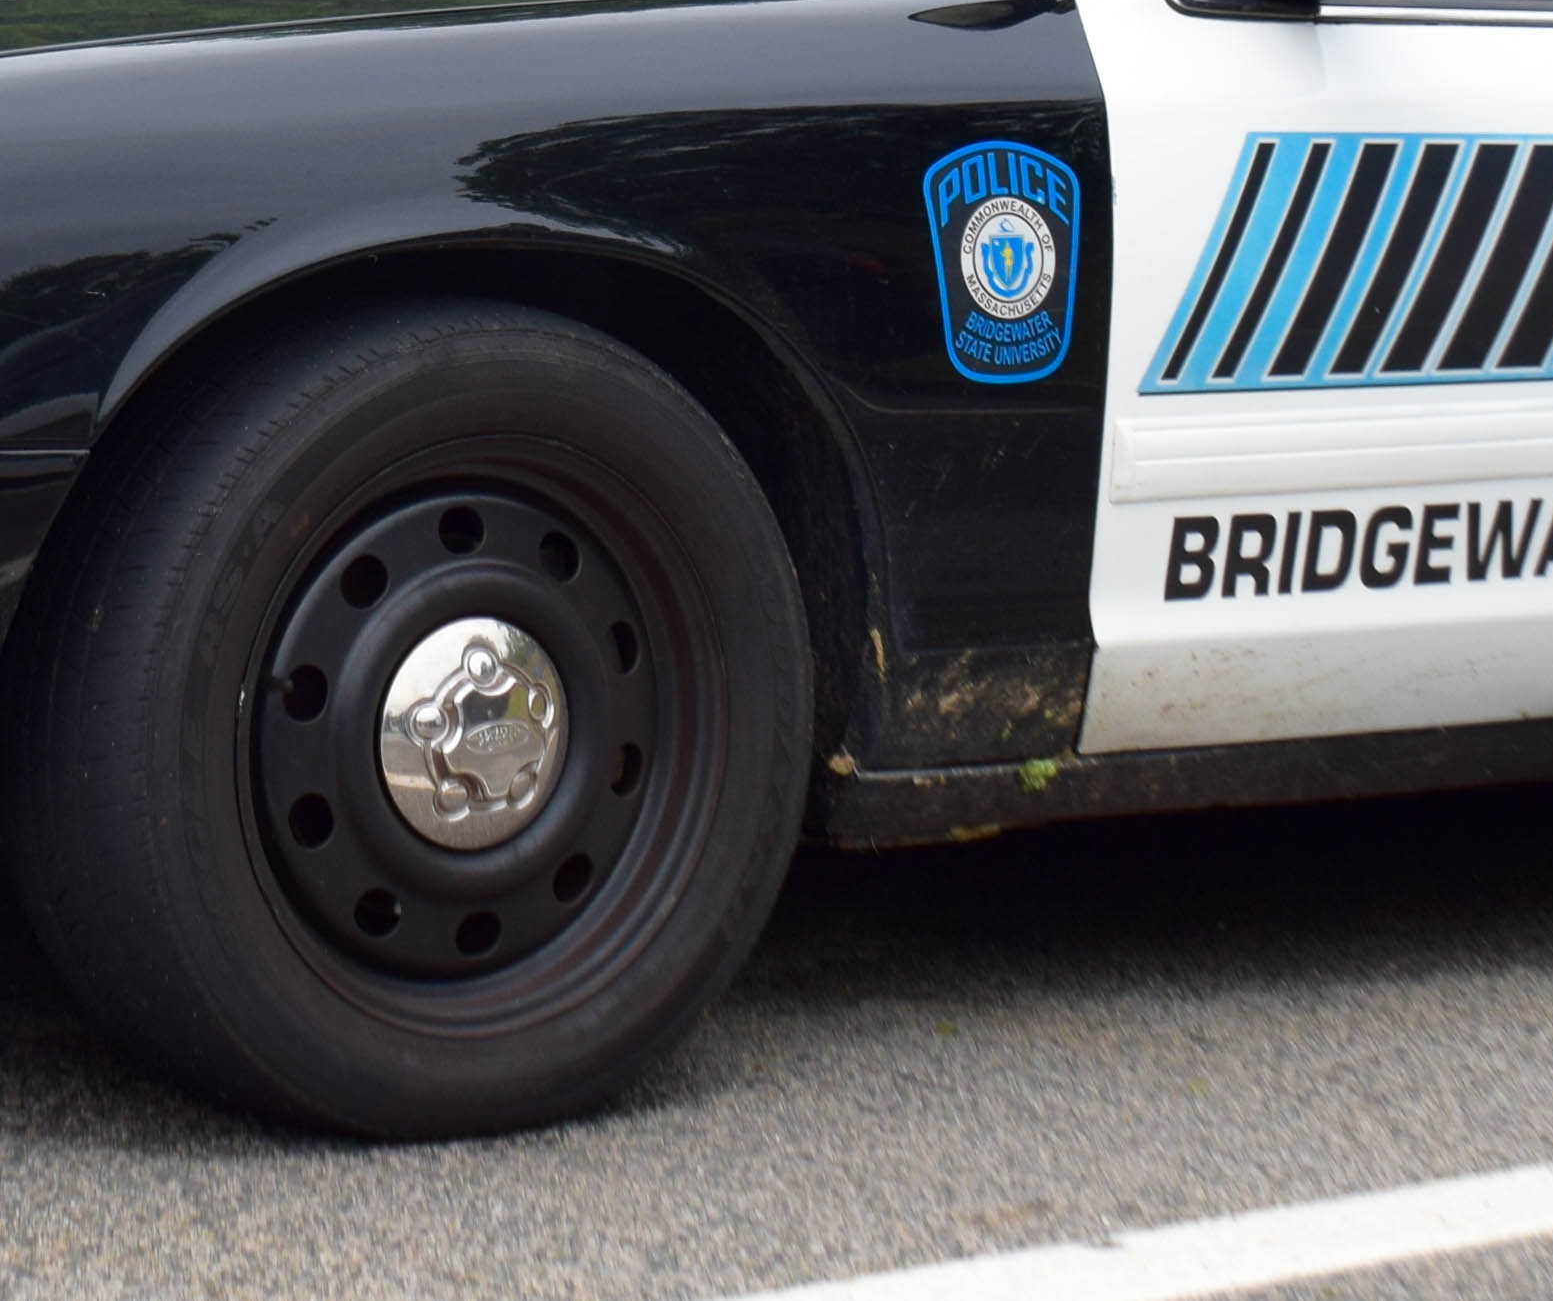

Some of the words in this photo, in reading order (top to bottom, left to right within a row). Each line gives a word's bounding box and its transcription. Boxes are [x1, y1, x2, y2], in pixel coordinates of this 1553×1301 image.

[938, 152, 1070, 227] POLICE
[962, 199, 1044, 255] COMMONWEALTH
[1041, 233, 1054, 253] OF
[966, 272, 1053, 317] MASSACHUSETTS
[955, 330, 993, 363] STATE
[993, 327, 1063, 365] UNIVERSITY
[965, 310, 1053, 343] BRIDGEWATER
